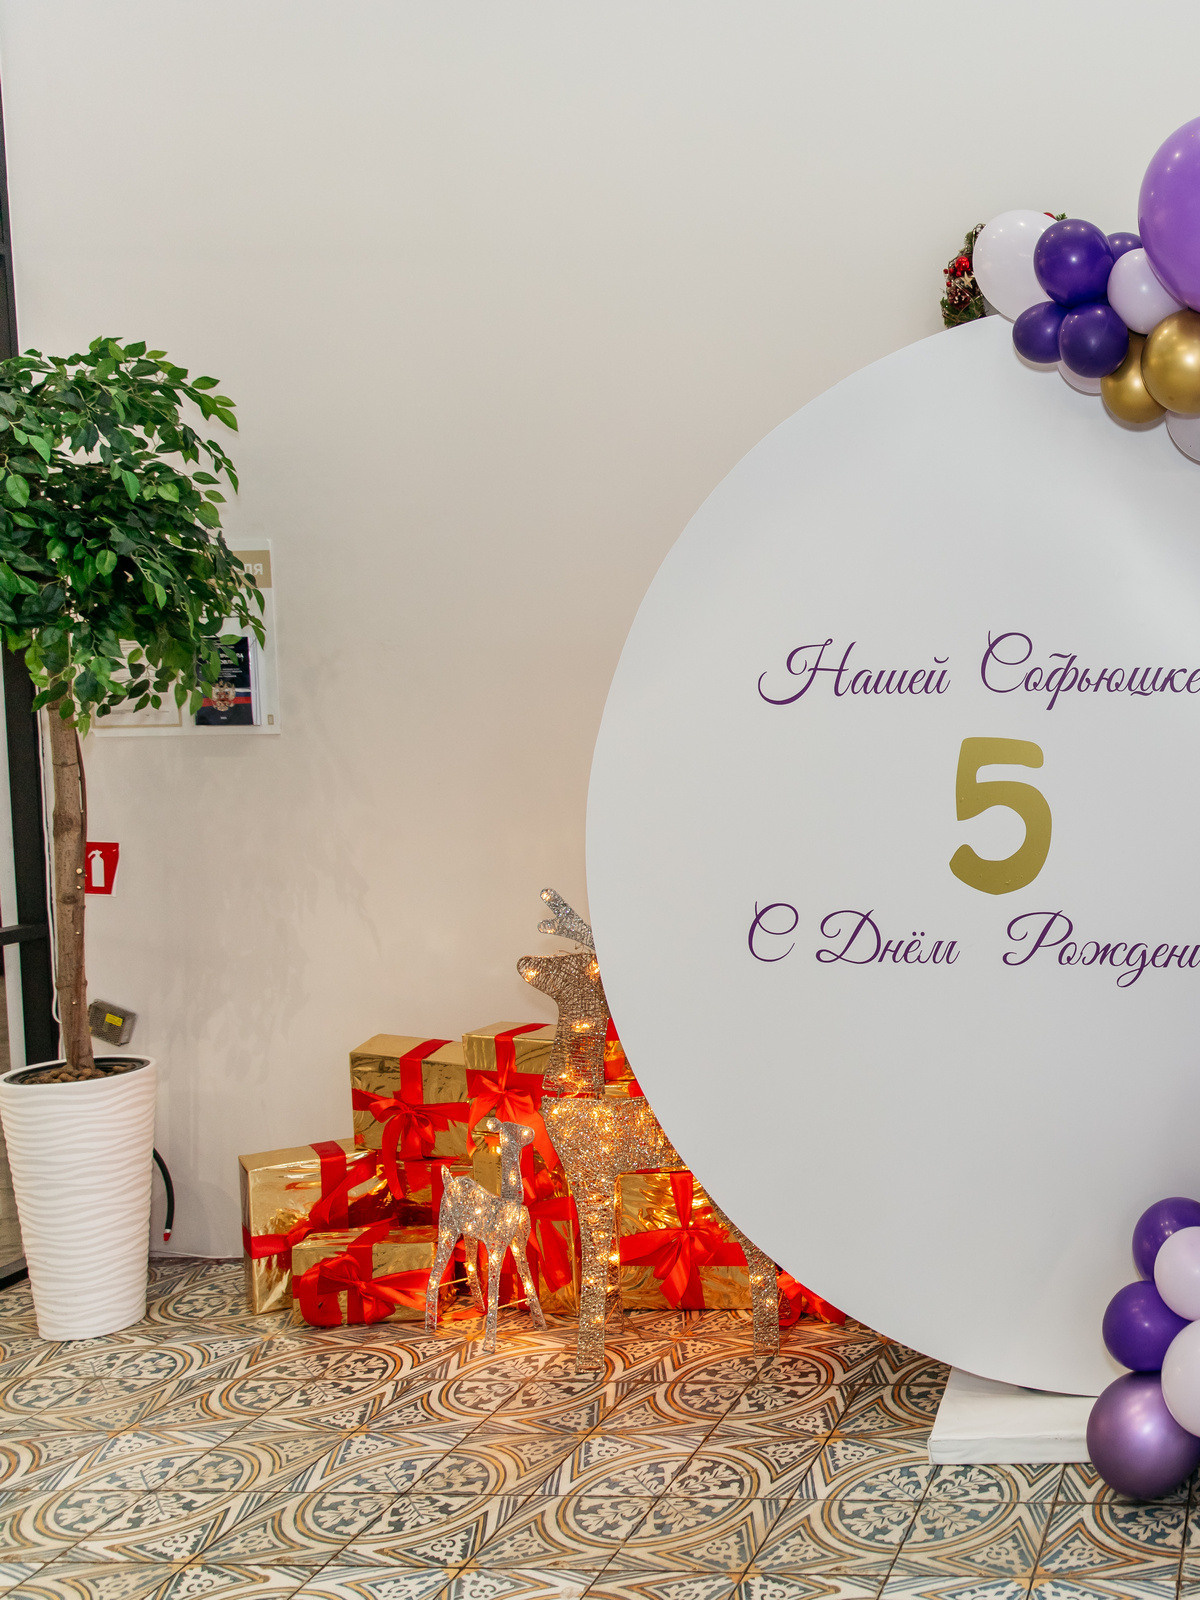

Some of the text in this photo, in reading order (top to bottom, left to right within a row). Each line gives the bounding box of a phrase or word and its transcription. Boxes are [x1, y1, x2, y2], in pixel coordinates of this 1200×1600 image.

[757, 637, 951, 706] Нашей
[949, 737, 1052, 896] 5
[747, 901, 799, 963] С
[815, 908, 961, 965] Днём
